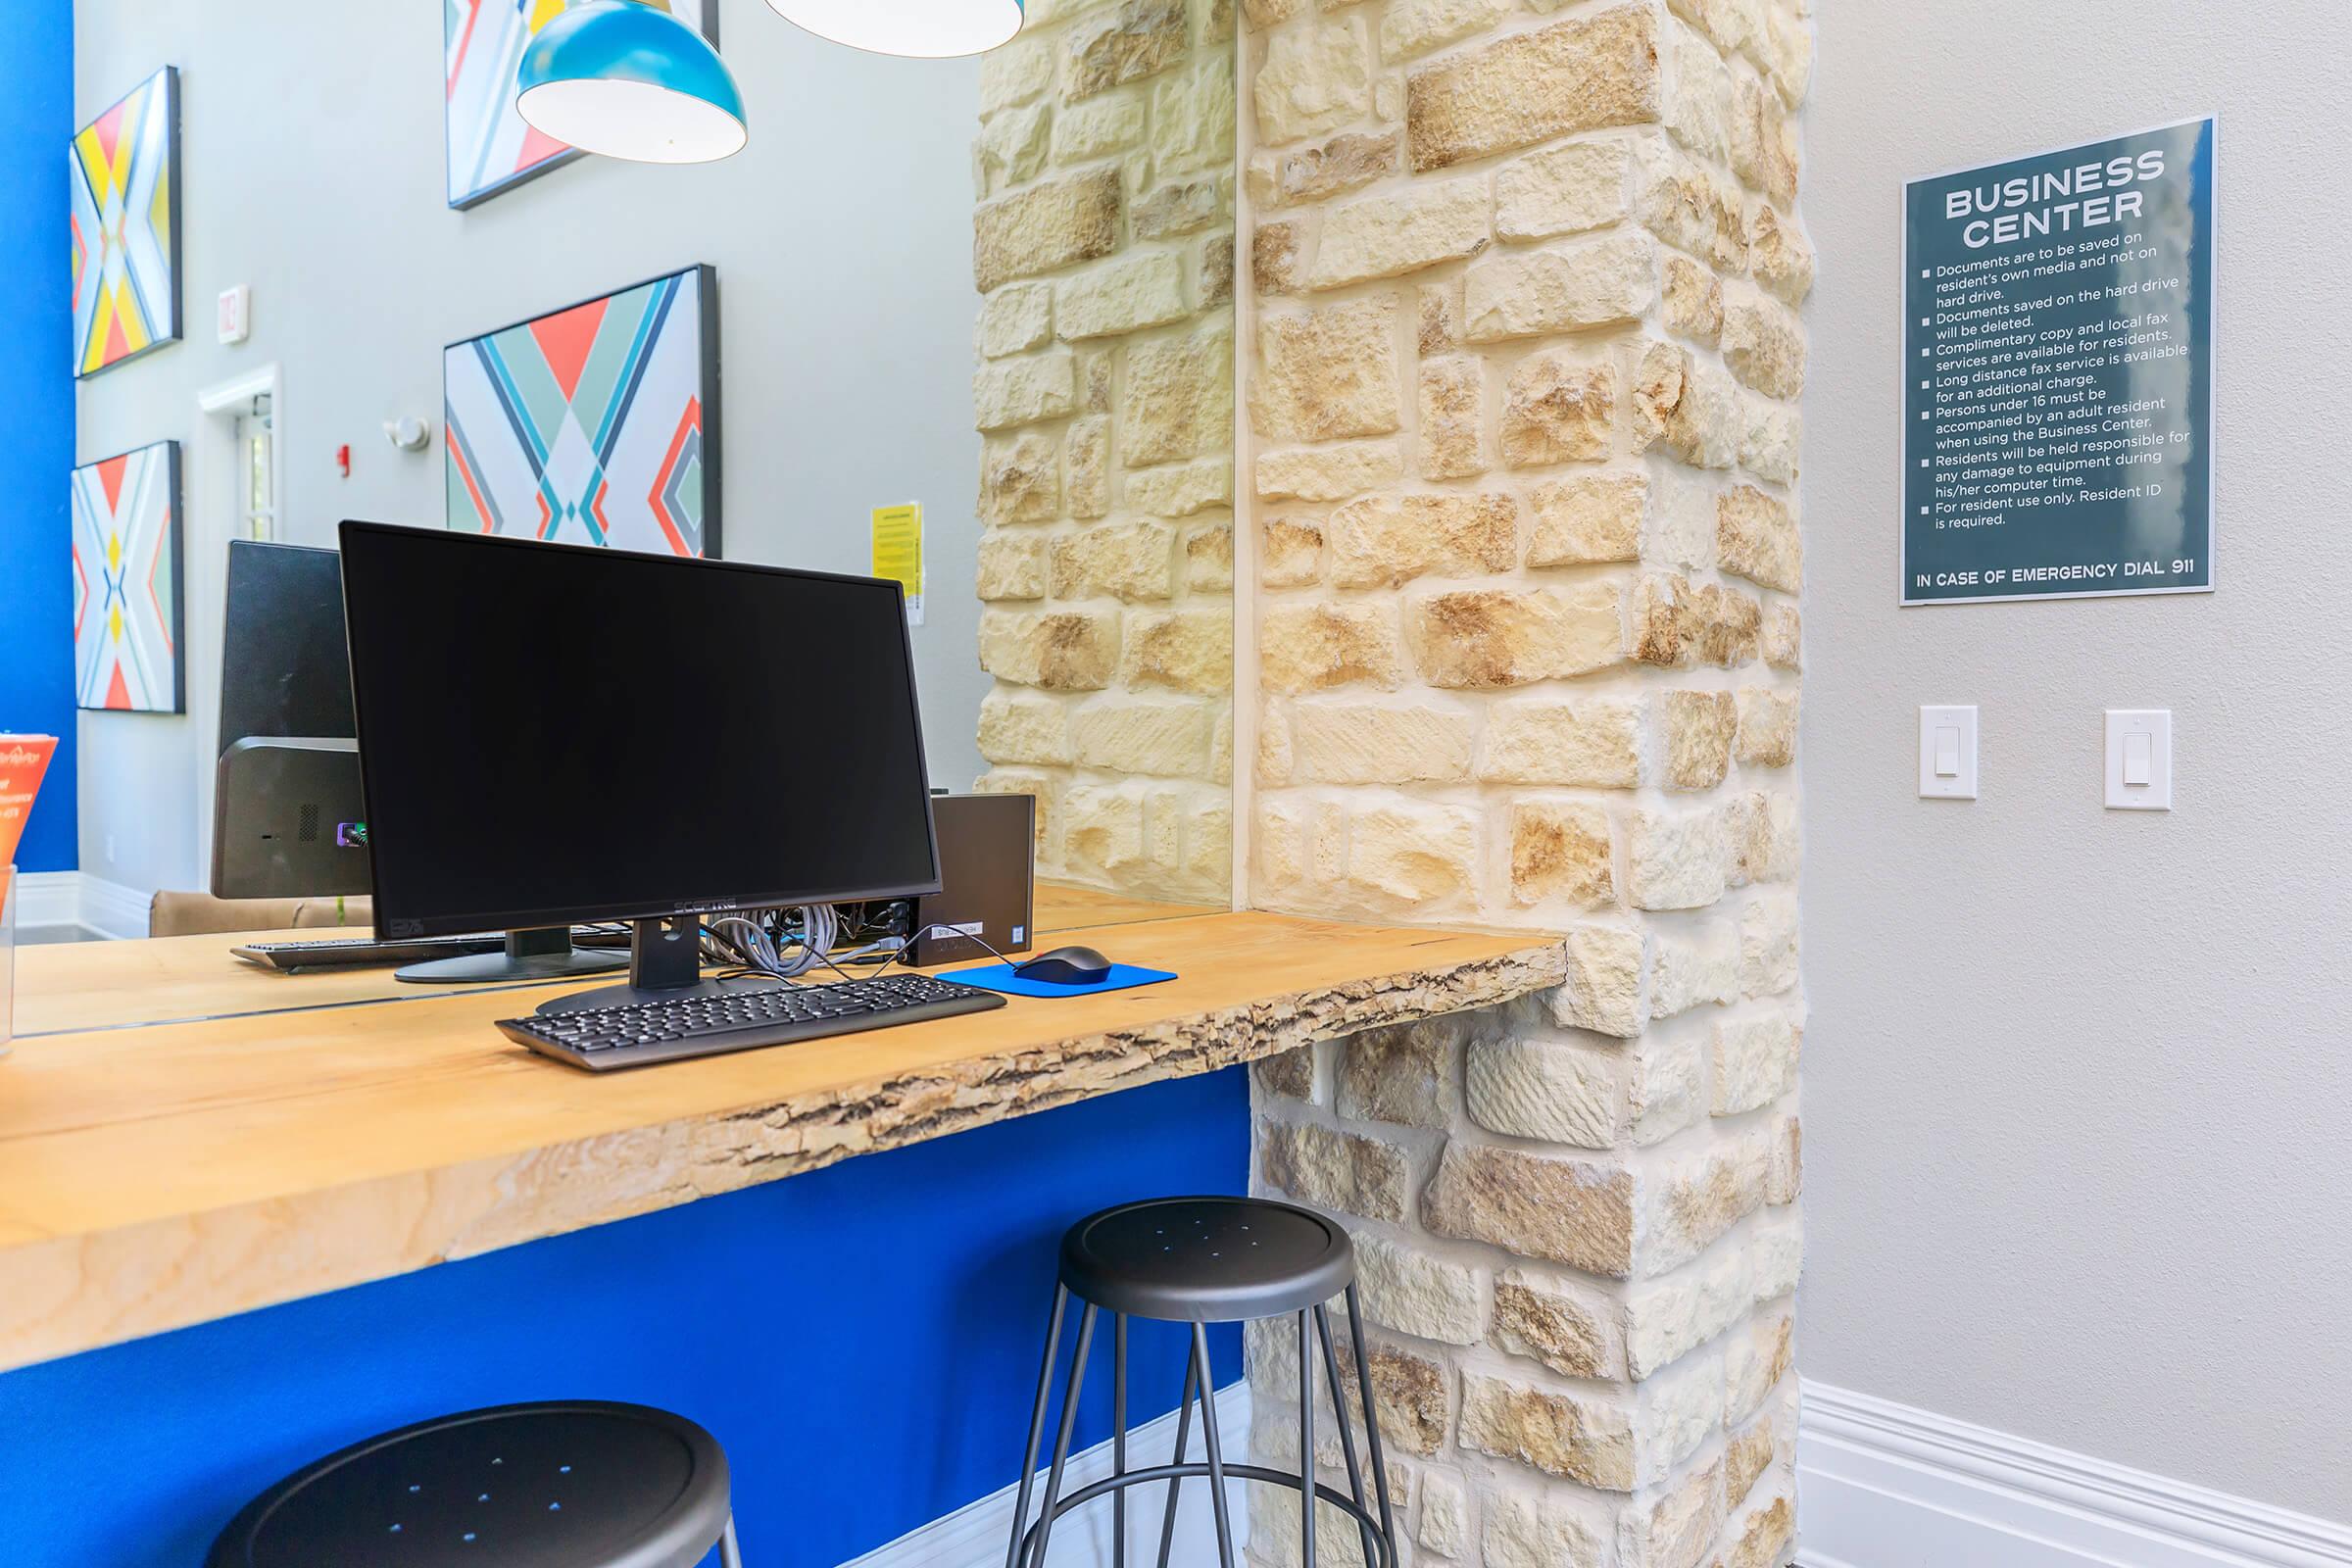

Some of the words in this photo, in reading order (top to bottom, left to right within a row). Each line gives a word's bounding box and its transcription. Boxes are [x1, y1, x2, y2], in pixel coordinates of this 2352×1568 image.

[1946, 150, 2165, 219] BUSINESS
[1963, 190, 2142, 248] CENTER
[1936, 256, 2010, 277] Documents
[2013, 252, 2034, 264] are
[2038, 248, 2053, 260] to
[2057, 244, 2075, 256] be
[2079, 234, 2119, 253] saved
[2124, 233, 2141, 244] on
[1936, 273, 1997, 293] resident's
[2001, 269, 2029, 282] own
[2034, 260, 2076, 276] media
[2079, 253, 2106, 269] and
[2110, 249, 2133, 264] not
[2138, 247, 2156, 259] on
[1936, 293, 1965, 309] hard
[1968, 289, 2004, 304] drive.
[1936, 304, 2010, 324] Documents
[2013, 295, 2052, 313] saved
[2056, 294, 2074, 306] on
[2079, 289, 2101, 302] the
[2105, 281, 2136, 298] hard
[2141, 277, 2179, 292] drive
[1936, 325, 1957, 340] will
[1961, 324, 1978, 336] be
[1980, 315, 2034, 333] deleted.
[1936, 333, 2035, 356] Complimentary
[2039, 327, 2074, 341] copy
[2077, 320, 2103, 335] and
[2108, 315, 2141, 331] local
[2146, 313, 2168, 325] fax
[1936, 356, 1987, 371] services
[1990, 353, 2012, 364] are
[2015, 342, 2075, 361] available
[2079, 339, 2099, 352] for
[2103, 329, 2172, 348] residents.
[1936, 375, 1968, 387] Long
[1972, 367, 2027, 382] distance
[2031, 363, 2051, 374] fax
[2055, 356, 2104, 371] service
[2109, 353, 2120, 365] is
[2124, 344, 2188, 363] available
[1936, 391, 1954, 403] for
[1957, 390, 1973, 401] an
[1976, 378, 2042, 398] additional
[2046, 374, 2096, 389] charge.
[1936, 404, 1985, 418] Persons
[1989, 398, 2029, 413] under
[2033, 394, 2046, 407] 16
[2050, 390, 2084, 405] must
[2088, 388, 2106, 400] be
[1936, 413, 2022, 434] accompanied
[2026, 412, 2043, 425] by
[2046, 411, 2063, 421] an
[2067, 404, 2103, 419] adult
[2107, 398, 2165, 415] resident
[1936, 437, 1970, 450] when
[1974, 432, 2008, 446] using
[2012, 429, 2034, 441] the
[2038, 423, 2097, 439] Business
[2101, 417, 2151, 432] Center.
[1936, 451, 1997, 466] Residents
[2001, 446, 2024, 460] will
[2028, 446, 2045, 458] be
[2049, 441, 2078, 455] held
[2082, 433, 2164, 452] responsible
[2169, 430, 2190, 443] for
[1936, 471, 1958, 483] any
[1961, 466, 2014, 480] damage
[2018, 464, 2033, 474] to
[2036, 455, 2111, 473] equipment
[2115, 453, 2161, 466] during
[1936, 484, 1981, 498] his/her
[1984, 478, 2048, 494] computer
[2052, 475, 2085, 487] time.
[1936, 502, 1957, 514] For
[1960, 497, 2013, 512] resident
[2017, 496, 2039, 507] use
[2043, 491, 2075, 505] only.
[2080, 486, 2140, 502] Resident
[2146, 484, 2161, 496] ID
[1936, 517, 1945, 529] is
[1948, 513, 2005, 529] required.
[1916, 573, 1931, 587] IN
[1936, 570, 1979, 586] CASE
[1984, 568, 2006, 584] OF
[2011, 563, 2118, 582] EMERGENCY
[2124, 561, 2165, 576] DIAL
[2172, 558, 2193, 573] 911
